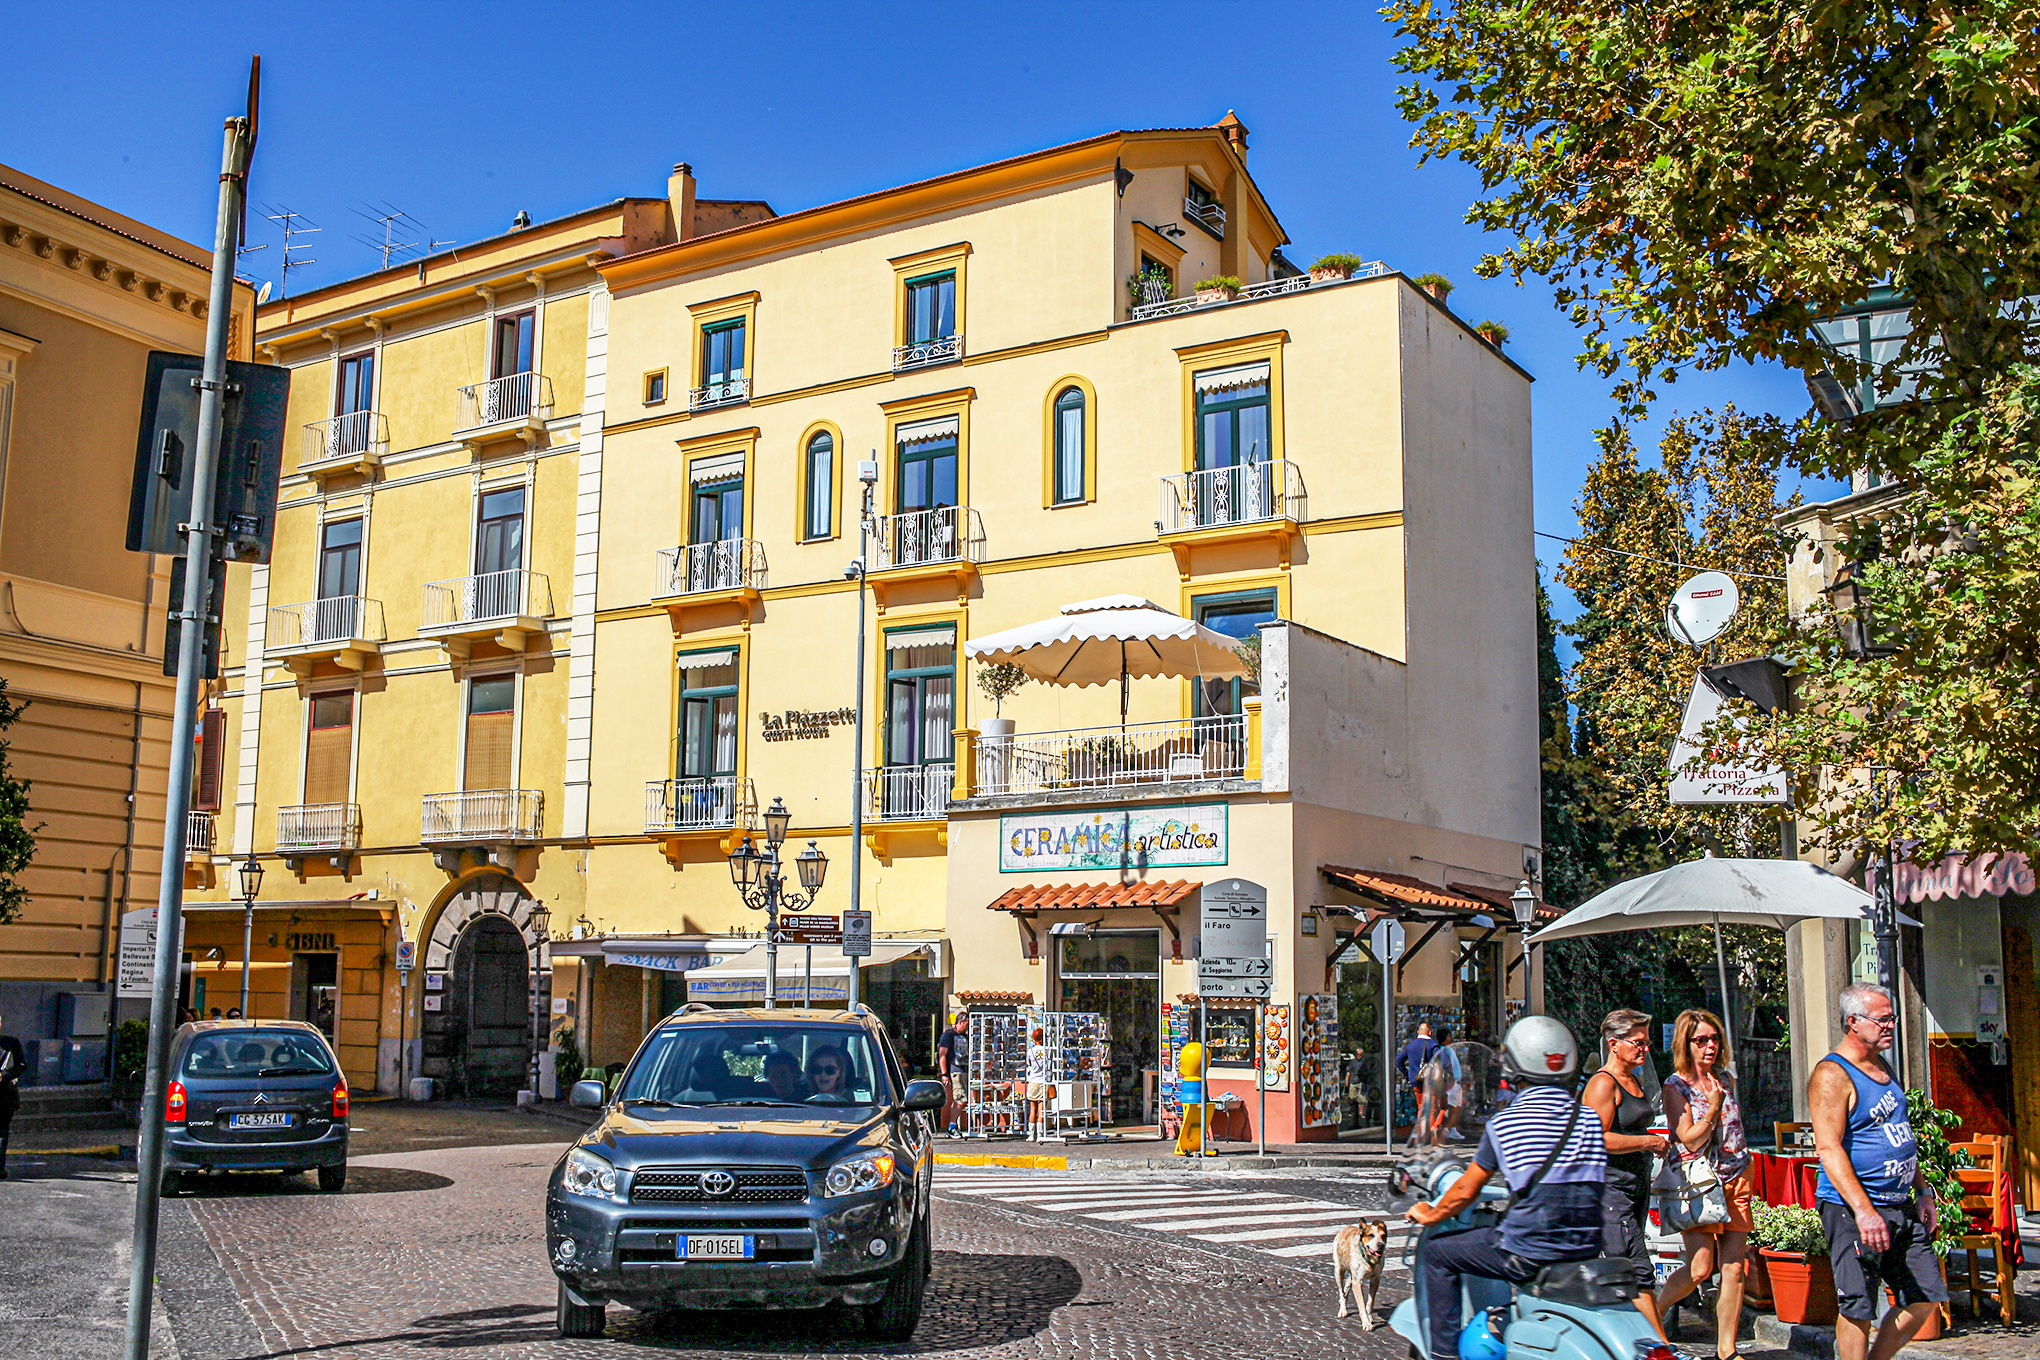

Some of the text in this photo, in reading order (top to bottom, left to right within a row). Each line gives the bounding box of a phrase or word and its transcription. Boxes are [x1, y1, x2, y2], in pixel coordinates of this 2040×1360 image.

[1723, 783, 1779, 796] Pizza
[1010, 822, 1219, 857] CERAMICA artistica
[619, 954, 724, 970] SNACK BAR
[691, 982, 709, 991] BAR
[1980, 1020, 1999, 1034] sky
[1869, 1090, 1899, 1120] STAGE
